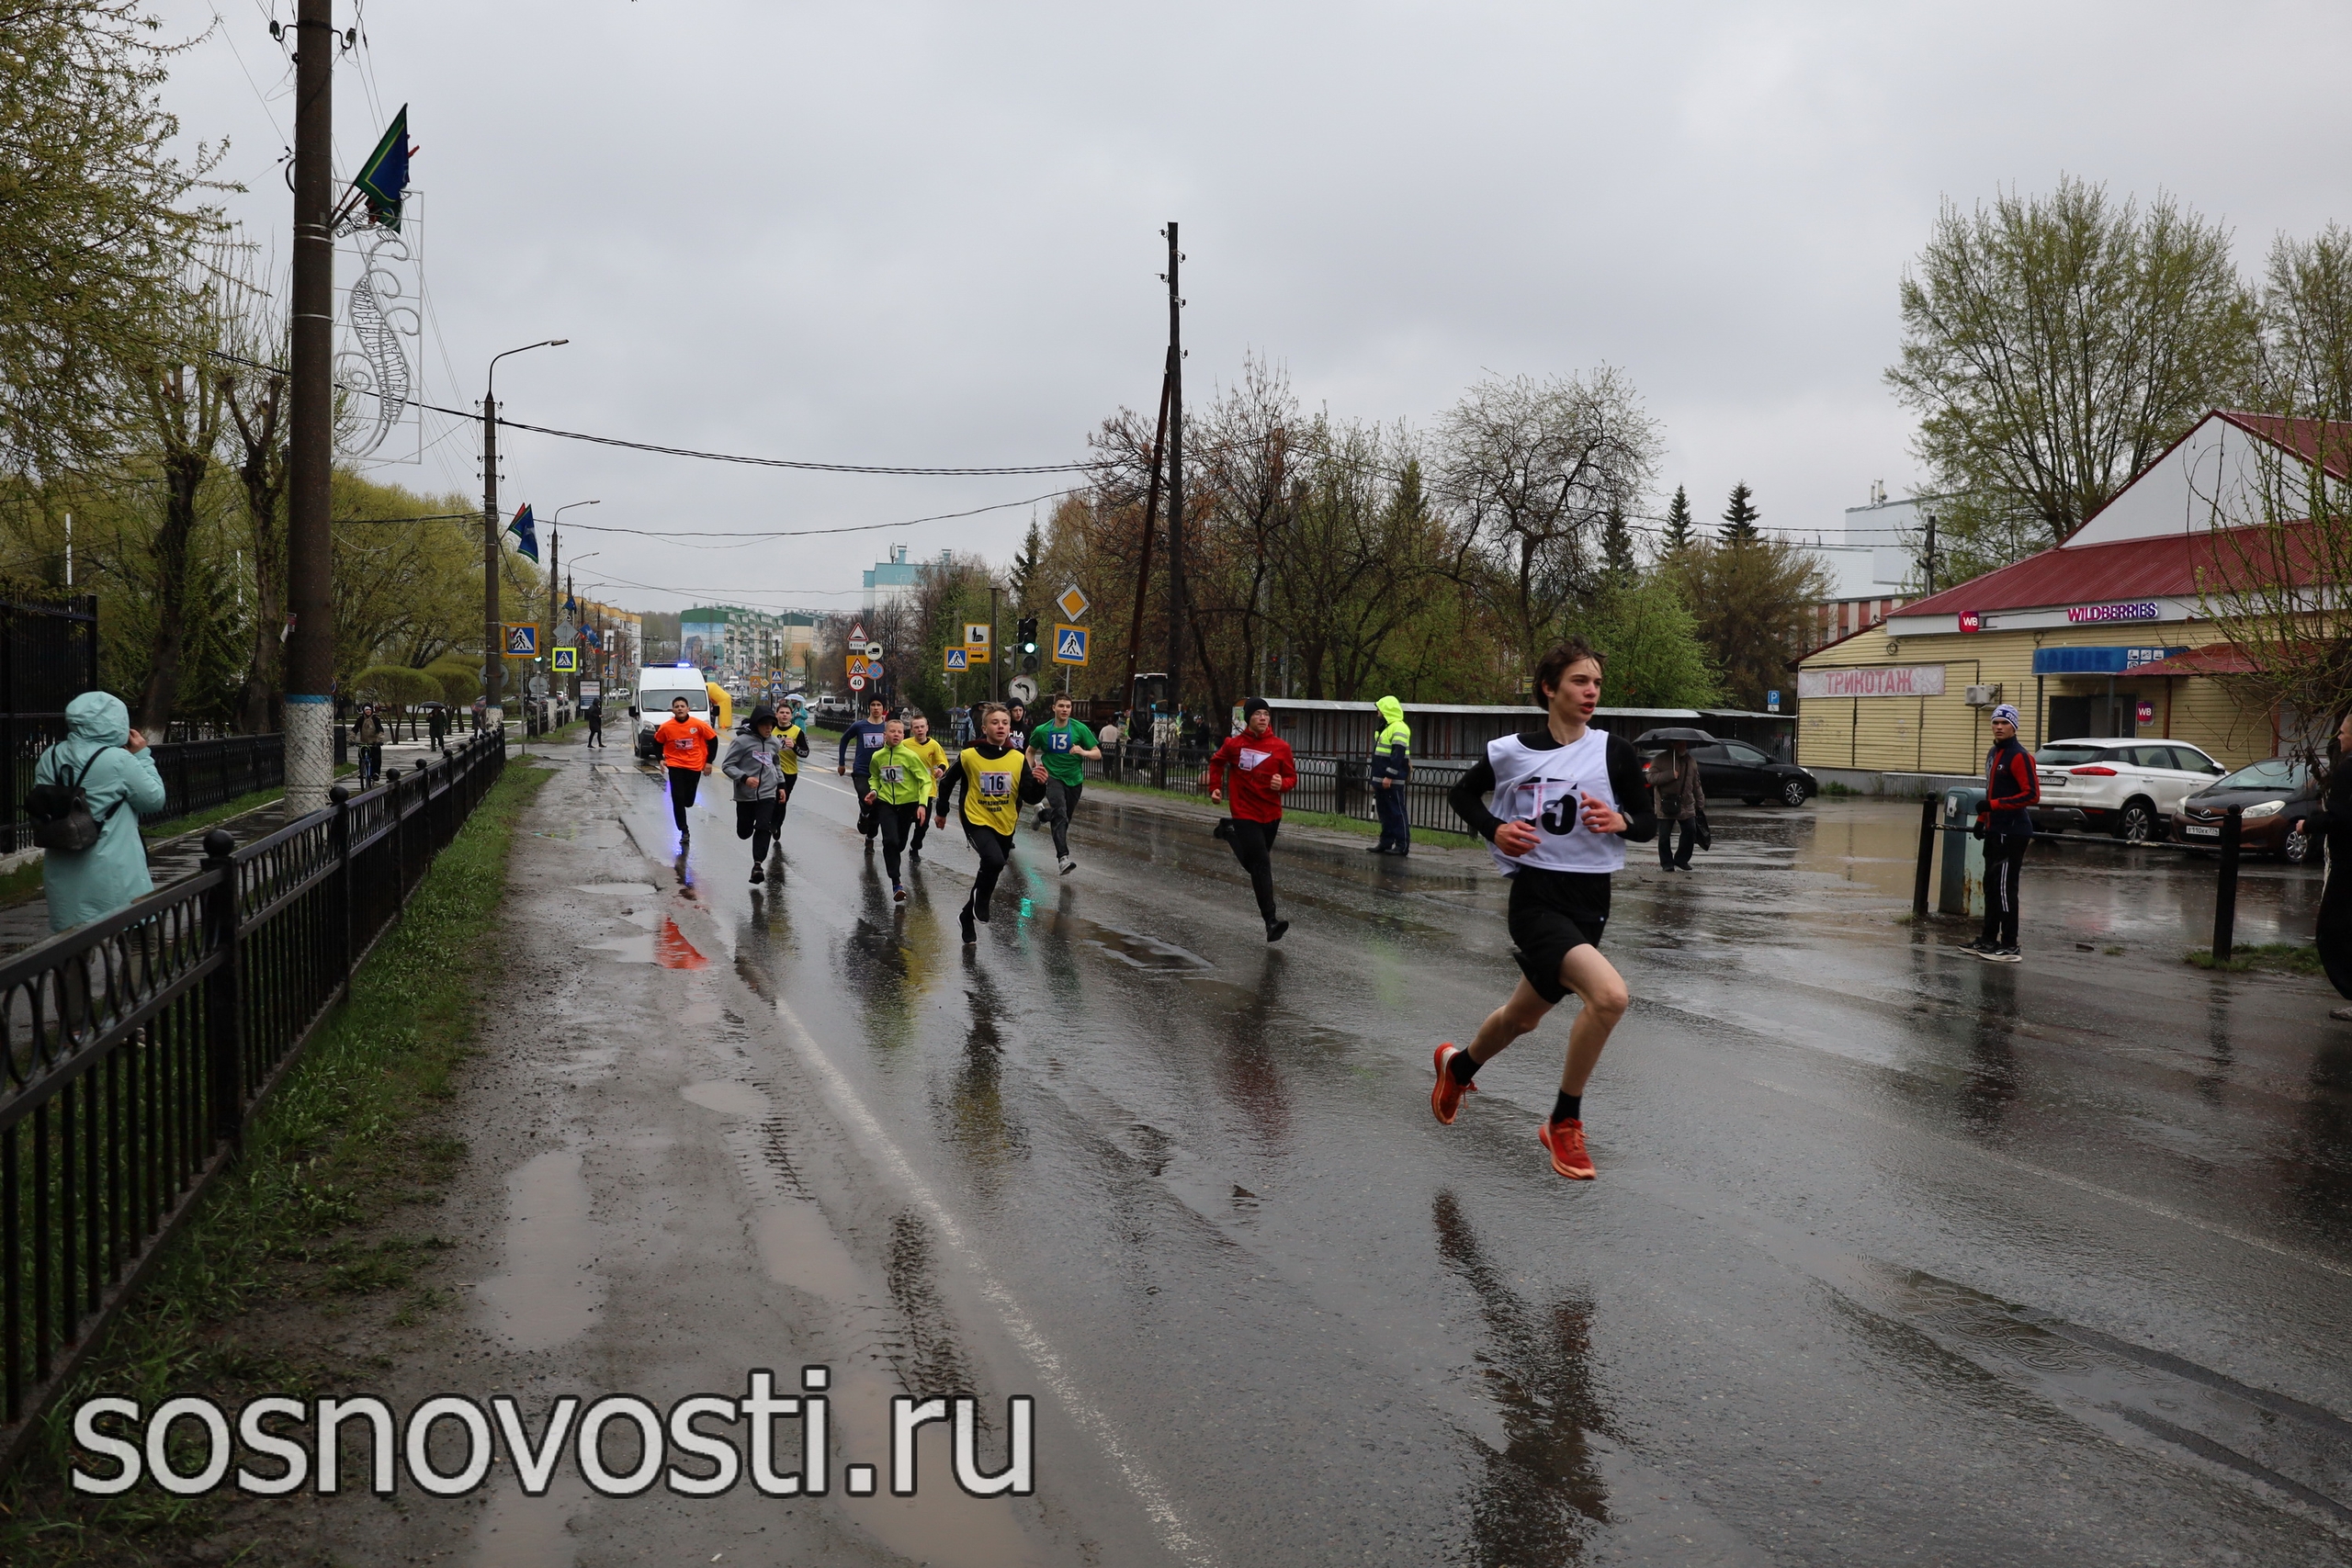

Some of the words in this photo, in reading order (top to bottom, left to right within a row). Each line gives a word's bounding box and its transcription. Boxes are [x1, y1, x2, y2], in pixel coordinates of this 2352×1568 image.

[2067, 602, 2158, 622] WILDBERRIES
[1962, 616, 1978, 626] WB
[1825, 669, 1913, 694] ТРИКОТАЖ
[2138, 707, 2152, 716] WB
[871, 736, 876, 745] 4
[1051, 734, 1068, 750] 13
[885, 768, 897, 780] 10
[989, 775, 1004, 791] 16
